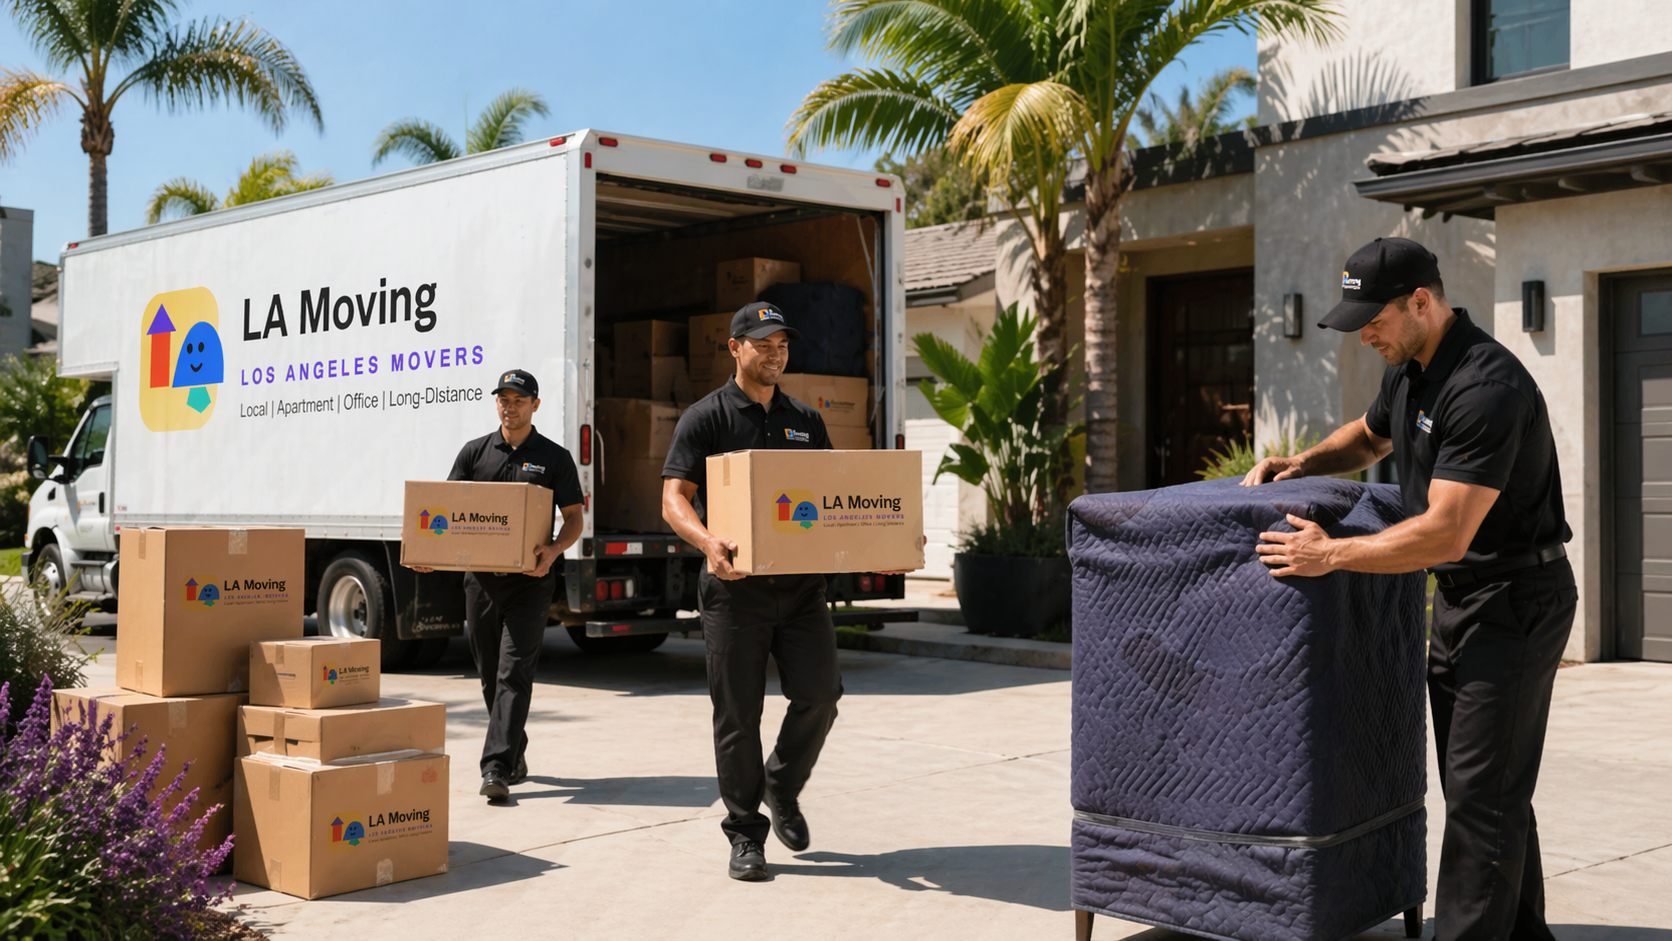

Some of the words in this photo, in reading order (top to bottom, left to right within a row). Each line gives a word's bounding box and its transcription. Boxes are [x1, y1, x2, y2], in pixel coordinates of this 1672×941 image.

[243, 294, 288, 341] LA
[300, 277, 437, 334] Moving
[241, 366, 275, 386] LOS
[285, 355, 379, 382] ANGELES
[391, 345, 483, 372] MOVERS
[240, 401, 268, 418] Local
[277, 396, 334, 417] Apartment
[344, 392, 379, 410] Office
[823, 495, 843, 509] LA
[848, 494, 902, 512] Moving
[452, 512, 466, 523] LA
[469, 512, 508, 526] Moving
[224, 580, 240, 591] LA
[244, 579, 286, 592] Moving
[369, 813, 385, 828] LA
[388, 808, 430, 823] Moving
